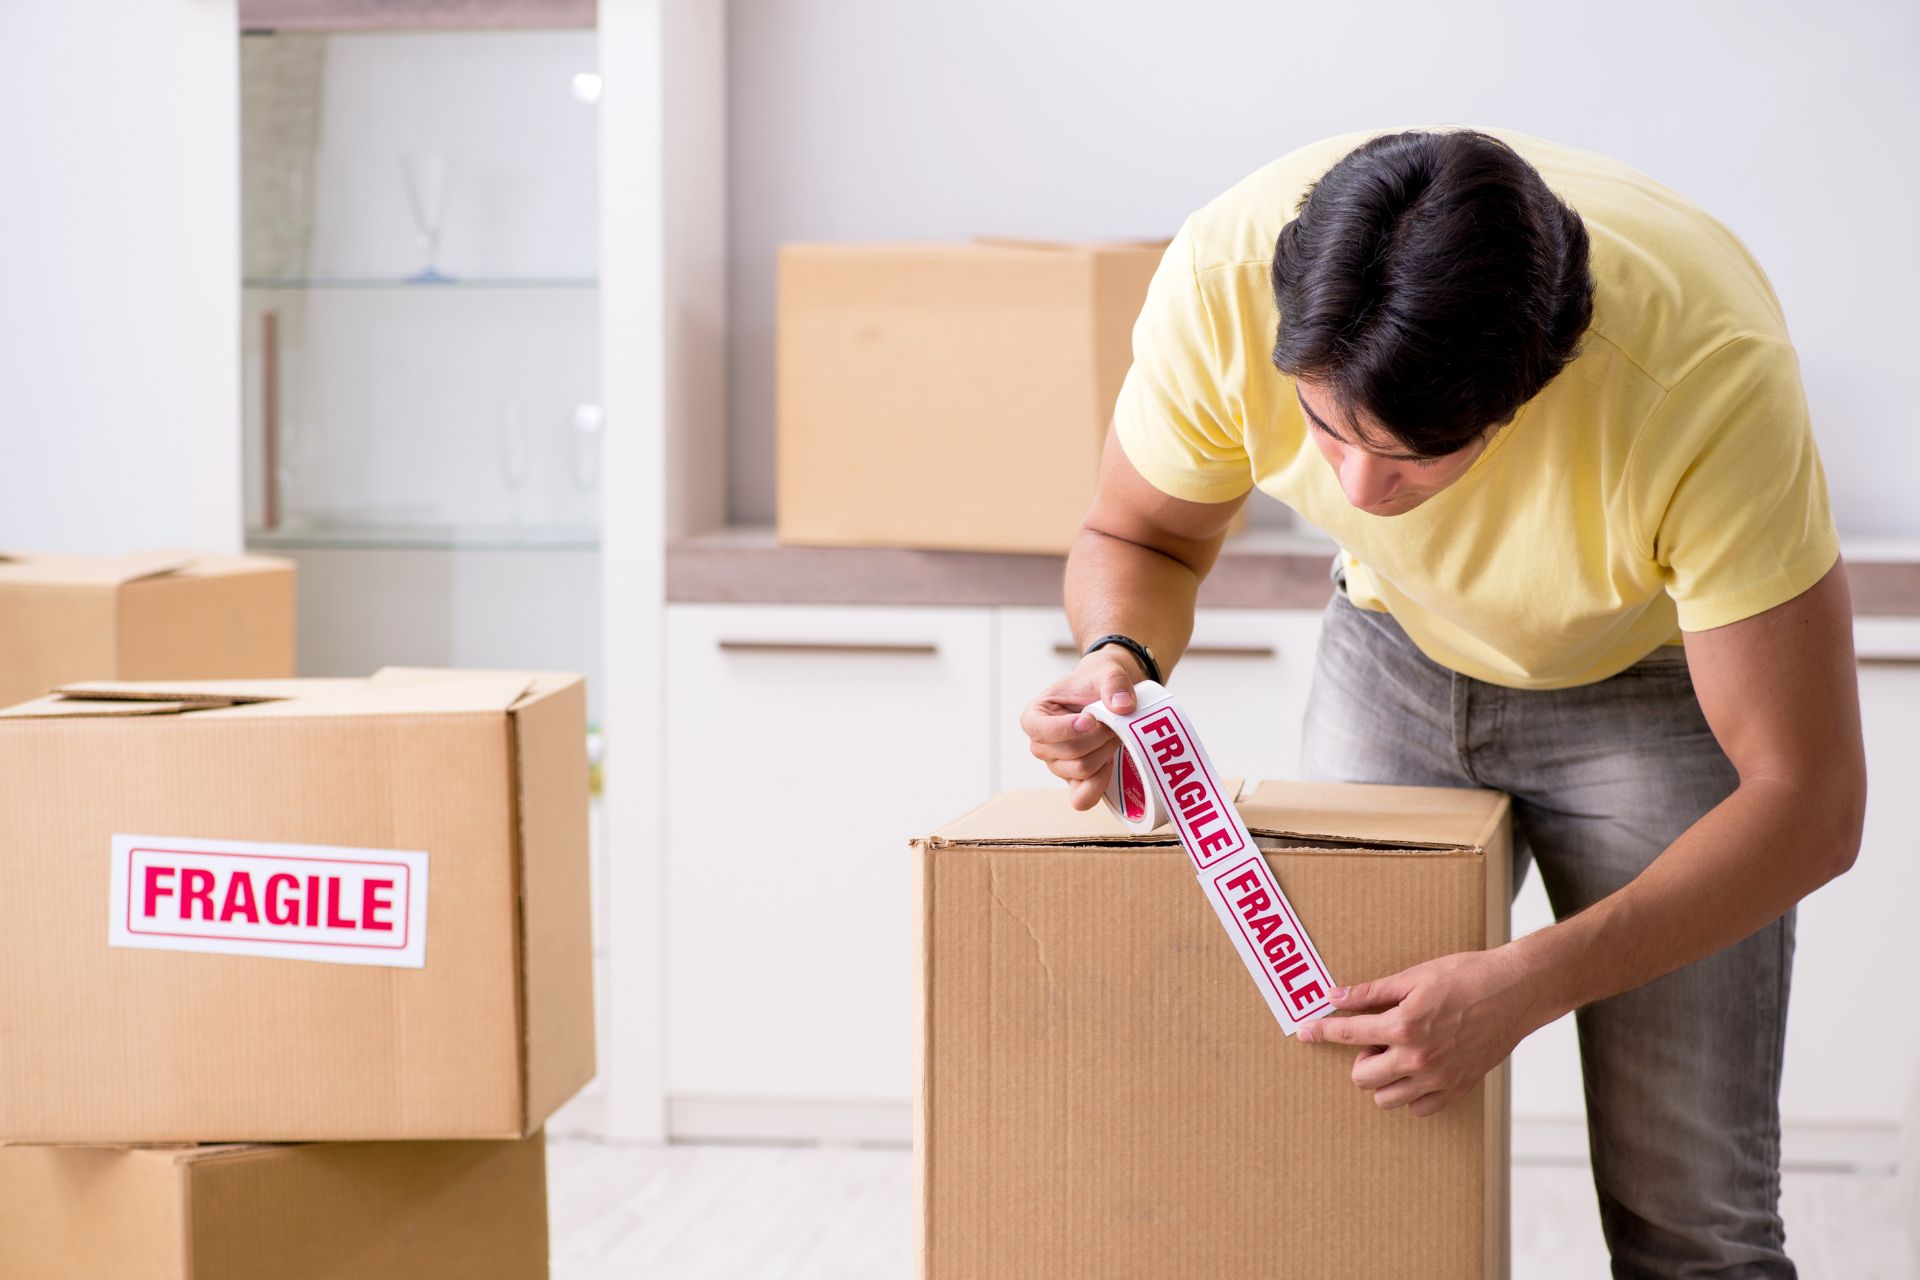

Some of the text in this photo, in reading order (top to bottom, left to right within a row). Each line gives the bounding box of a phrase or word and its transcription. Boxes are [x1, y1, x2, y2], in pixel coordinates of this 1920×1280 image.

[1141, 716, 1233, 859] FRAGILE
[143, 866, 394, 931] FRAGILE
[1225, 869, 1325, 1012] FRAGILE
